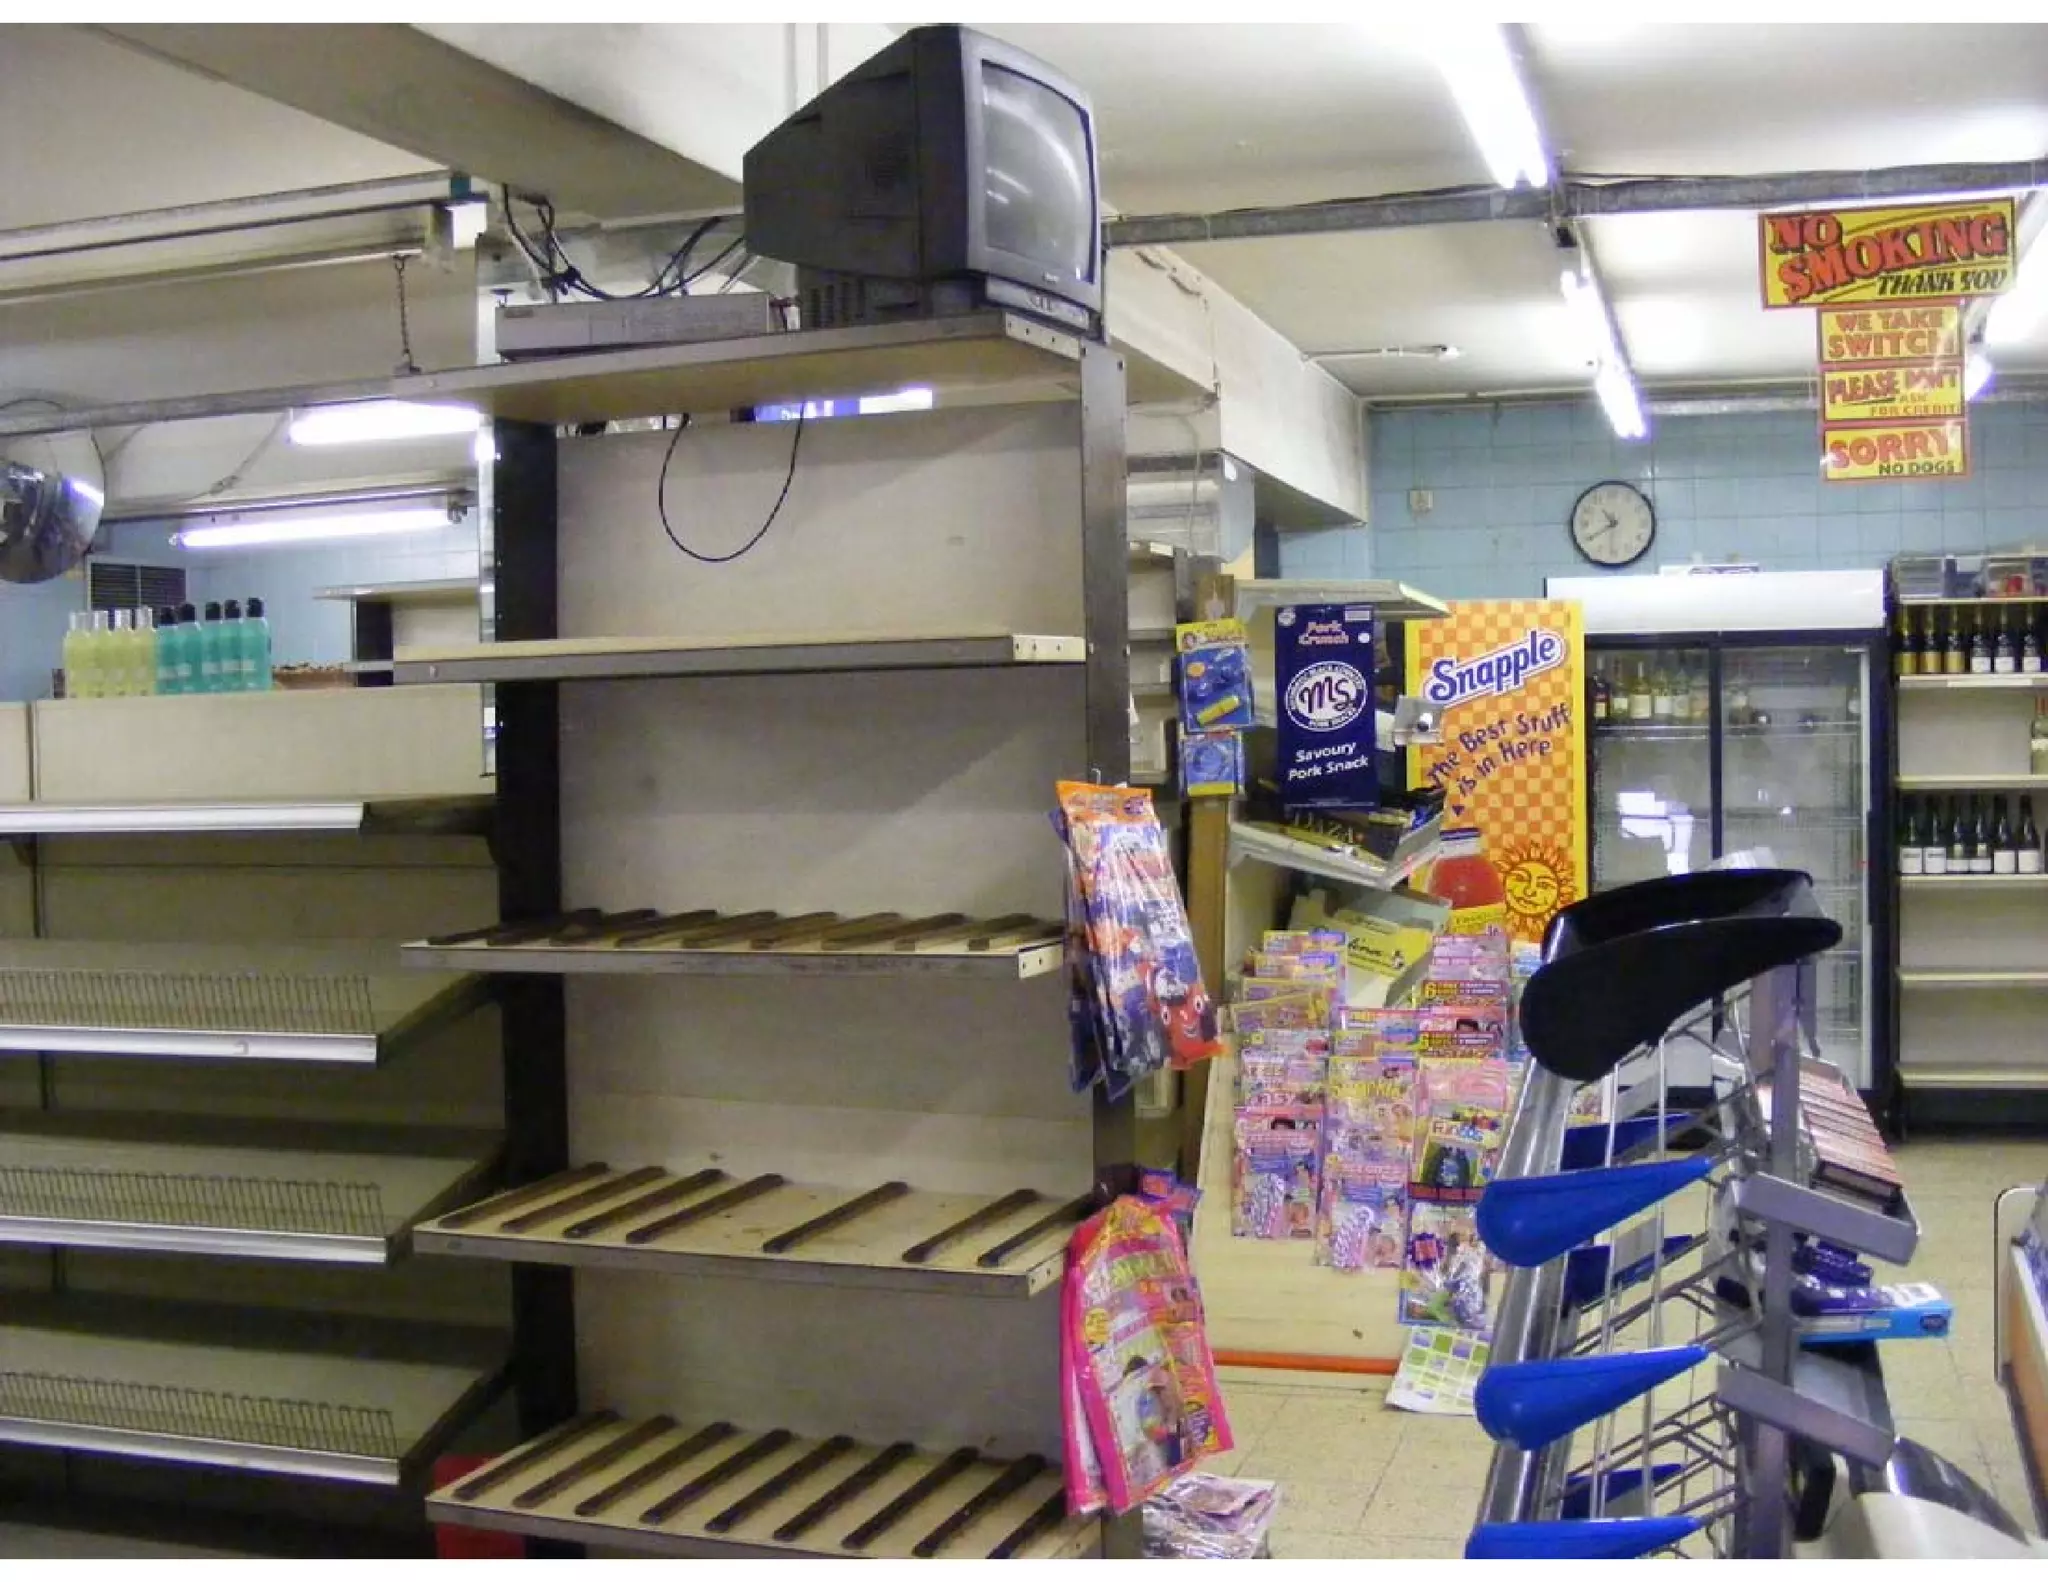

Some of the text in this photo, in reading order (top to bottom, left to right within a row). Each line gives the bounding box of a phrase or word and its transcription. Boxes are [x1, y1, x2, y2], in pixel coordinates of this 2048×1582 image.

[1768, 213, 1843, 254] NO
[1778, 212, 2009, 301] SMOKING
[1877, 268, 2008, 296] THANK YOU
[1836, 309, 1943, 332] WE TAKE
[1827, 370, 1899, 404] PLEASE
[1871, 404, 1900, 417] FOR
[1828, 429, 1949, 468] SORRY
[1878, 460, 1955, 475] NO DOGS
[1430, 630, 1557, 702] Snapple
[1459, 720, 1507, 753] Best
[1516, 702, 1572, 736] Stuff
[1295, 742, 1357, 763] Savoury
[1498, 738, 1552, 763] Here
[1288, 755, 1370, 781] Pork Snack
